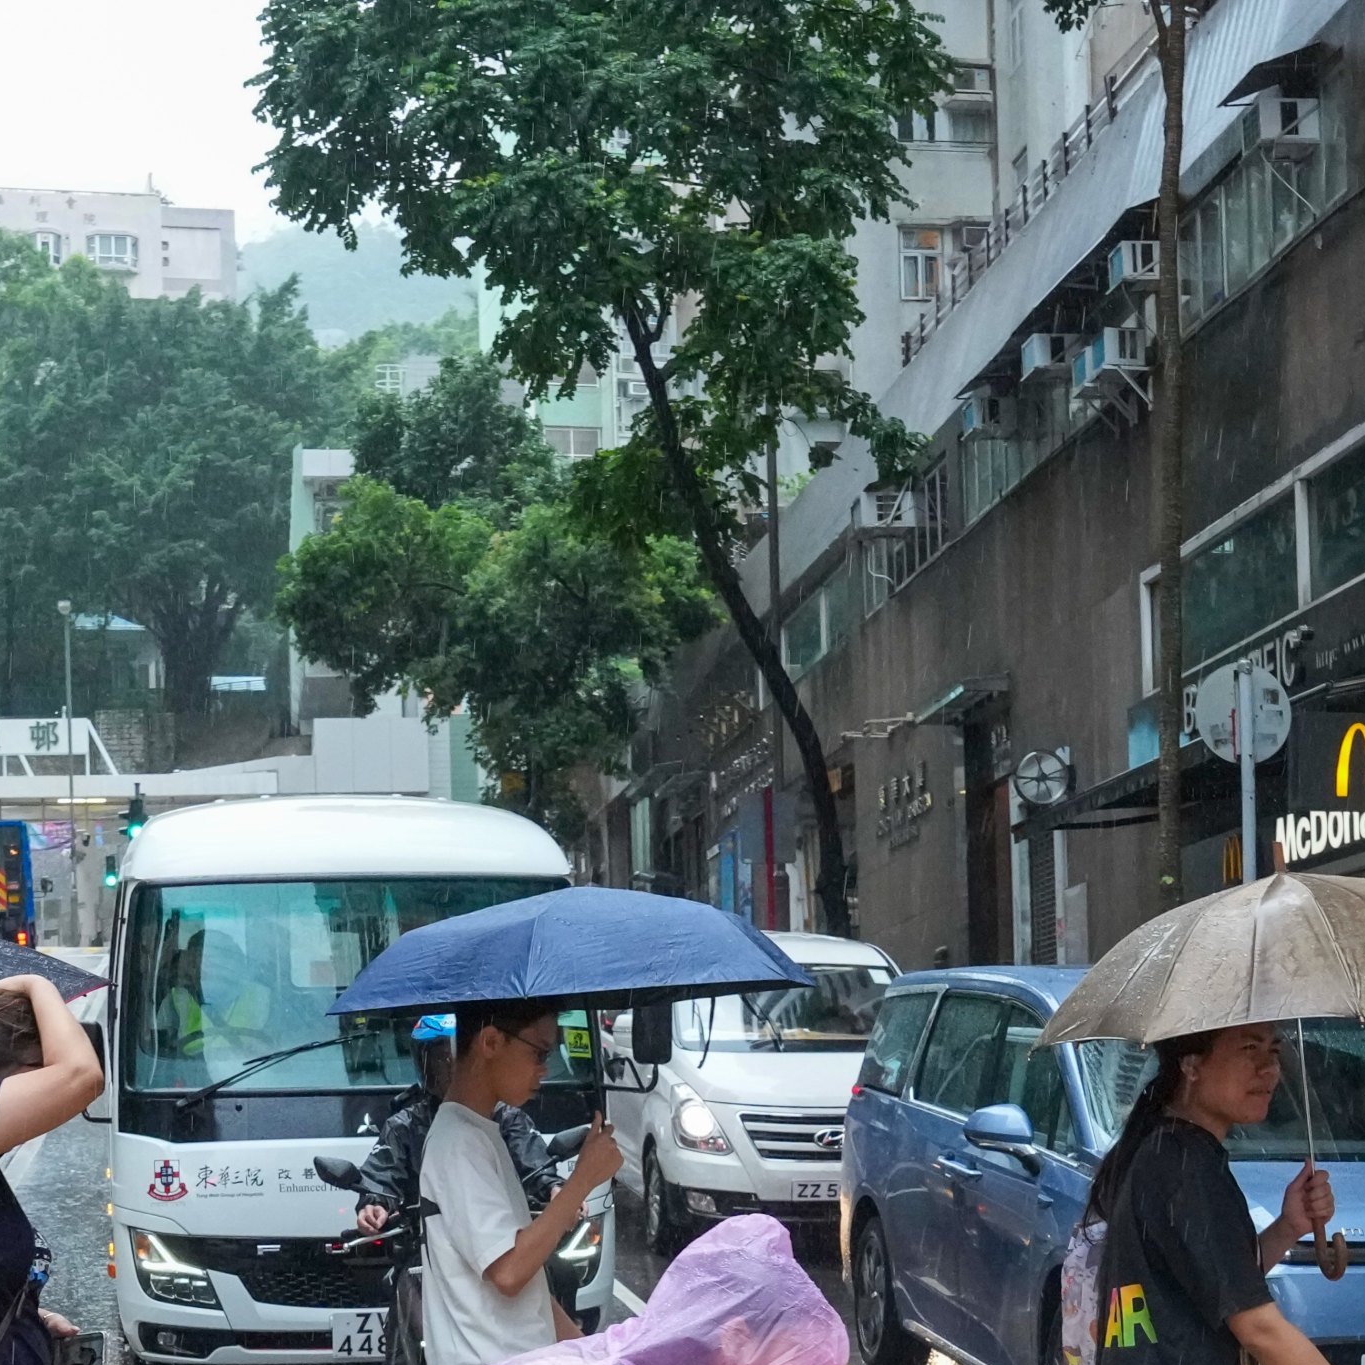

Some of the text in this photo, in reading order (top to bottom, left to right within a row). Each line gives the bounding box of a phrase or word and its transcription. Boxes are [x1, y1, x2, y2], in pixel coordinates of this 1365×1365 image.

[195, 1165, 264, 1189] 東華三院
[279, 1182, 327, 1193] Enhanced
